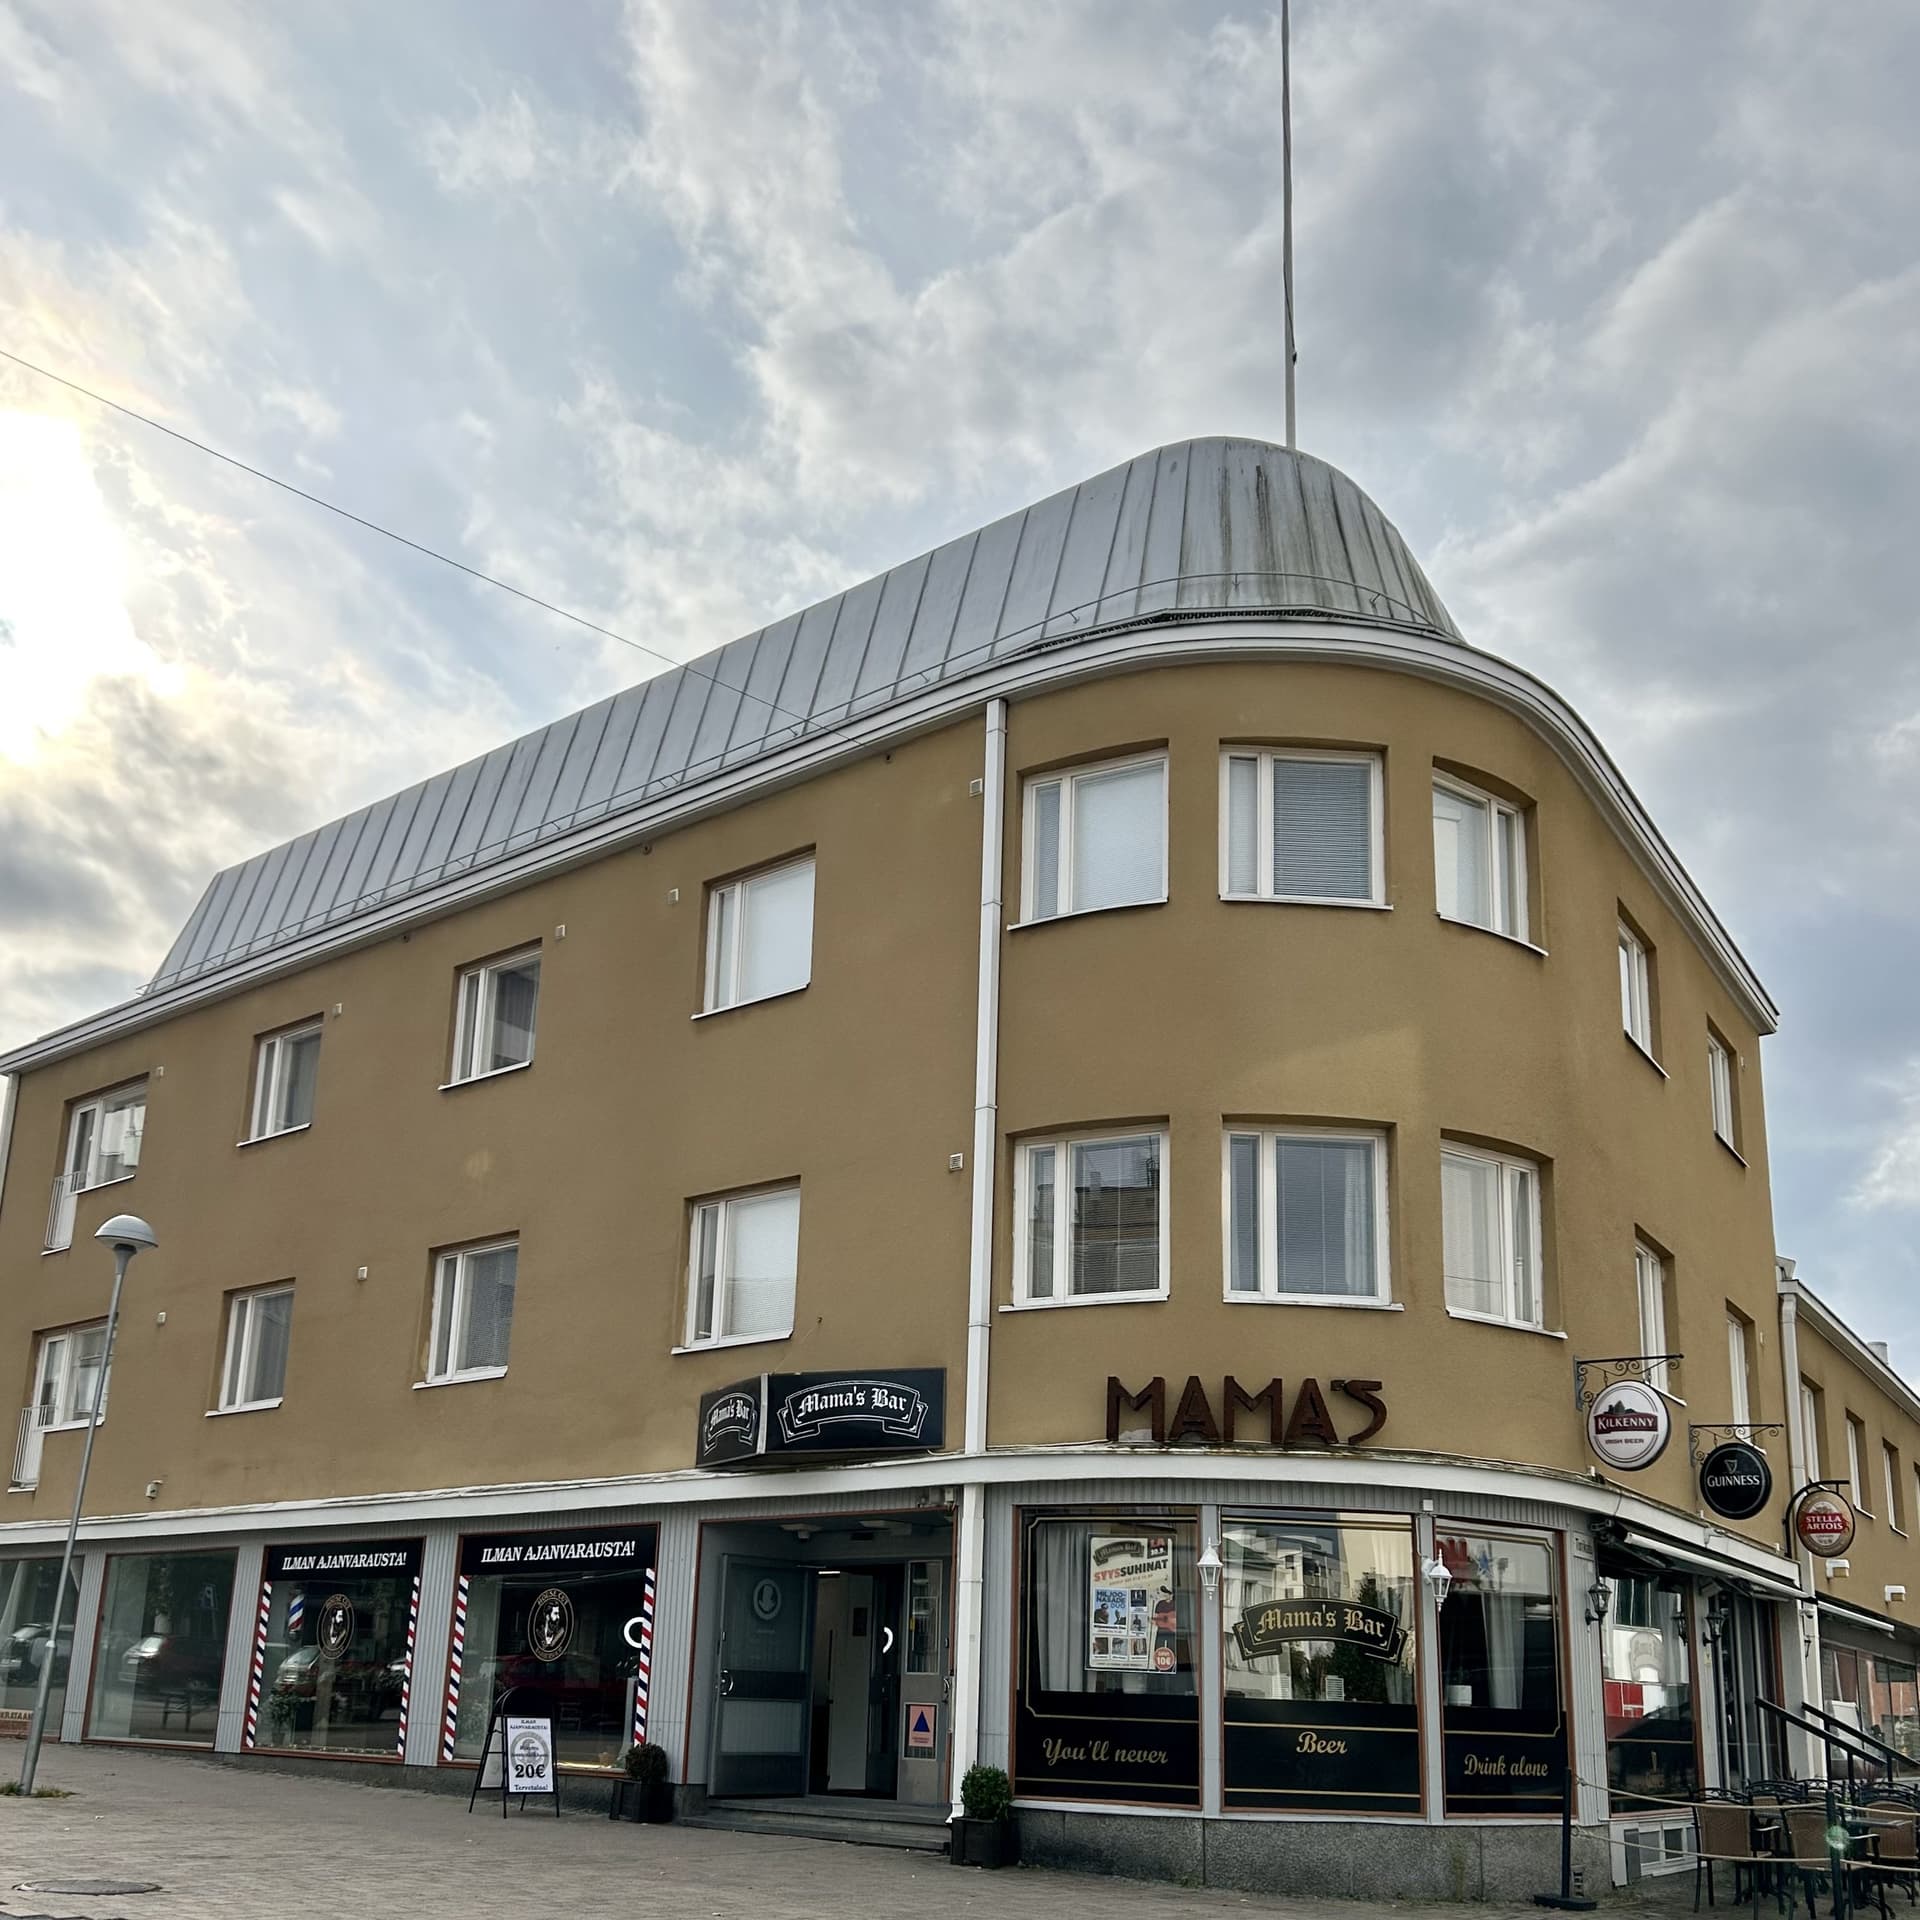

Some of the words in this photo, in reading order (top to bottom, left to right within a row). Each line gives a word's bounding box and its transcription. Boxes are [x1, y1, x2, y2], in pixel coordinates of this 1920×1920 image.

[736, 1399, 750, 1420] Bar
[797, 1386, 865, 1417] Mama's
[871, 1387, 908, 1412] Bar
[1598, 1417, 1655, 1430] KILKENNY
[1707, 1475, 1760, 1487] GUINNESS
[1806, 1515, 1842, 1523] STELLA
[282, 1556, 317, 1570] ILMAN
[316, 1552, 407, 1569] AJANVARAUSTA!
[481, 1546, 523, 1563] ILMAN
[523, 1541, 636, 1561] AJANVARAUSTA!
[1256, 1604, 1336, 1635] Mama's
[1344, 1608, 1386, 1638] Bar
[1042, 1738, 1110, 1766] You'll
[1114, 1749, 1168, 1764] never
[1296, 1731, 1348, 1754] Beer
[515, 1764, 546, 1778] 20€
[1464, 1753, 1507, 1776] Drink
[1510, 1755, 1549, 1777] alone
